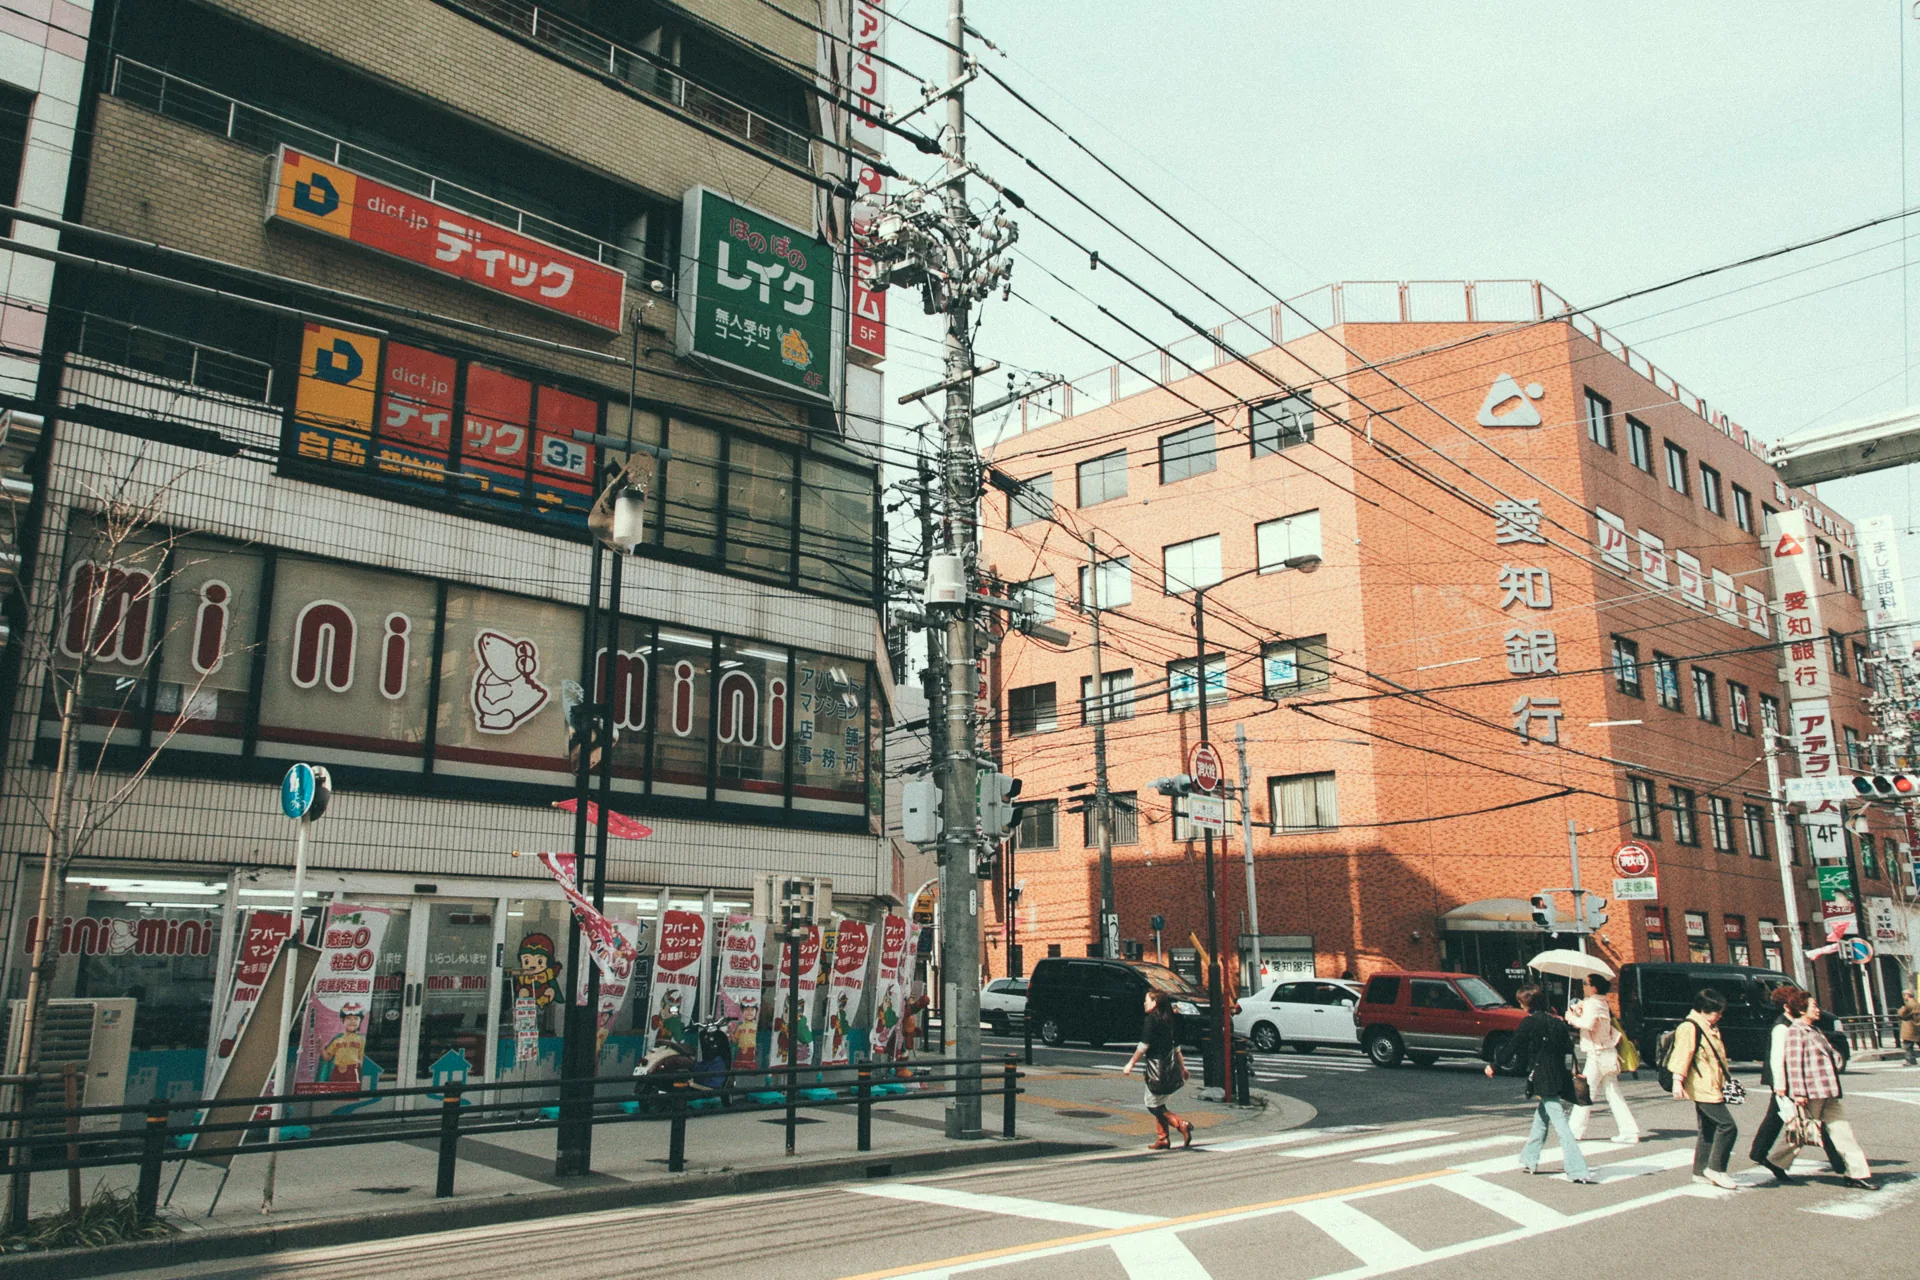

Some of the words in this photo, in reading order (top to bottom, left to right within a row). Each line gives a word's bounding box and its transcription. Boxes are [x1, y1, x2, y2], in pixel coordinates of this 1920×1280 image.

[436, 218, 574, 298] ディック
[730, 217, 807, 270] ほのぼの
[717, 240, 815, 316] レイク
[715, 307, 771, 340] 無人受付
[715, 325, 771, 350] コーナー
[860, 325, 876, 341] 5F
[804, 371, 823, 387] 4F
[386, 390, 525, 455] ディック
[547, 441, 585, 471] 3F
[1493, 498, 1563, 745] 愛知銀行
[1784, 590, 1818, 687] 愛知銀行
[59, 558, 412, 700] mini
[594, 647, 787, 751] mini
[800, 666, 861, 695] アパート
[800, 691, 860, 720] マンション
[799, 719, 860, 748] 店舗
[798, 744, 859, 772] 事務所
[1799, 714, 1839, 814] アデラス
[1816, 827, 1838, 843] 4F
[133, 918, 214, 957] mini
[664, 923, 699, 934] アパート
[665, 937, 703, 947] マンション
[429, 953, 488, 965] いらっしゃいませ
[1270, 960, 1314, 972] 愛知銀行
[427, 976, 454, 989] mini
[461, 976, 487, 989] mini
[656, 972, 676, 984] mini
[678, 973, 698, 988] mini
